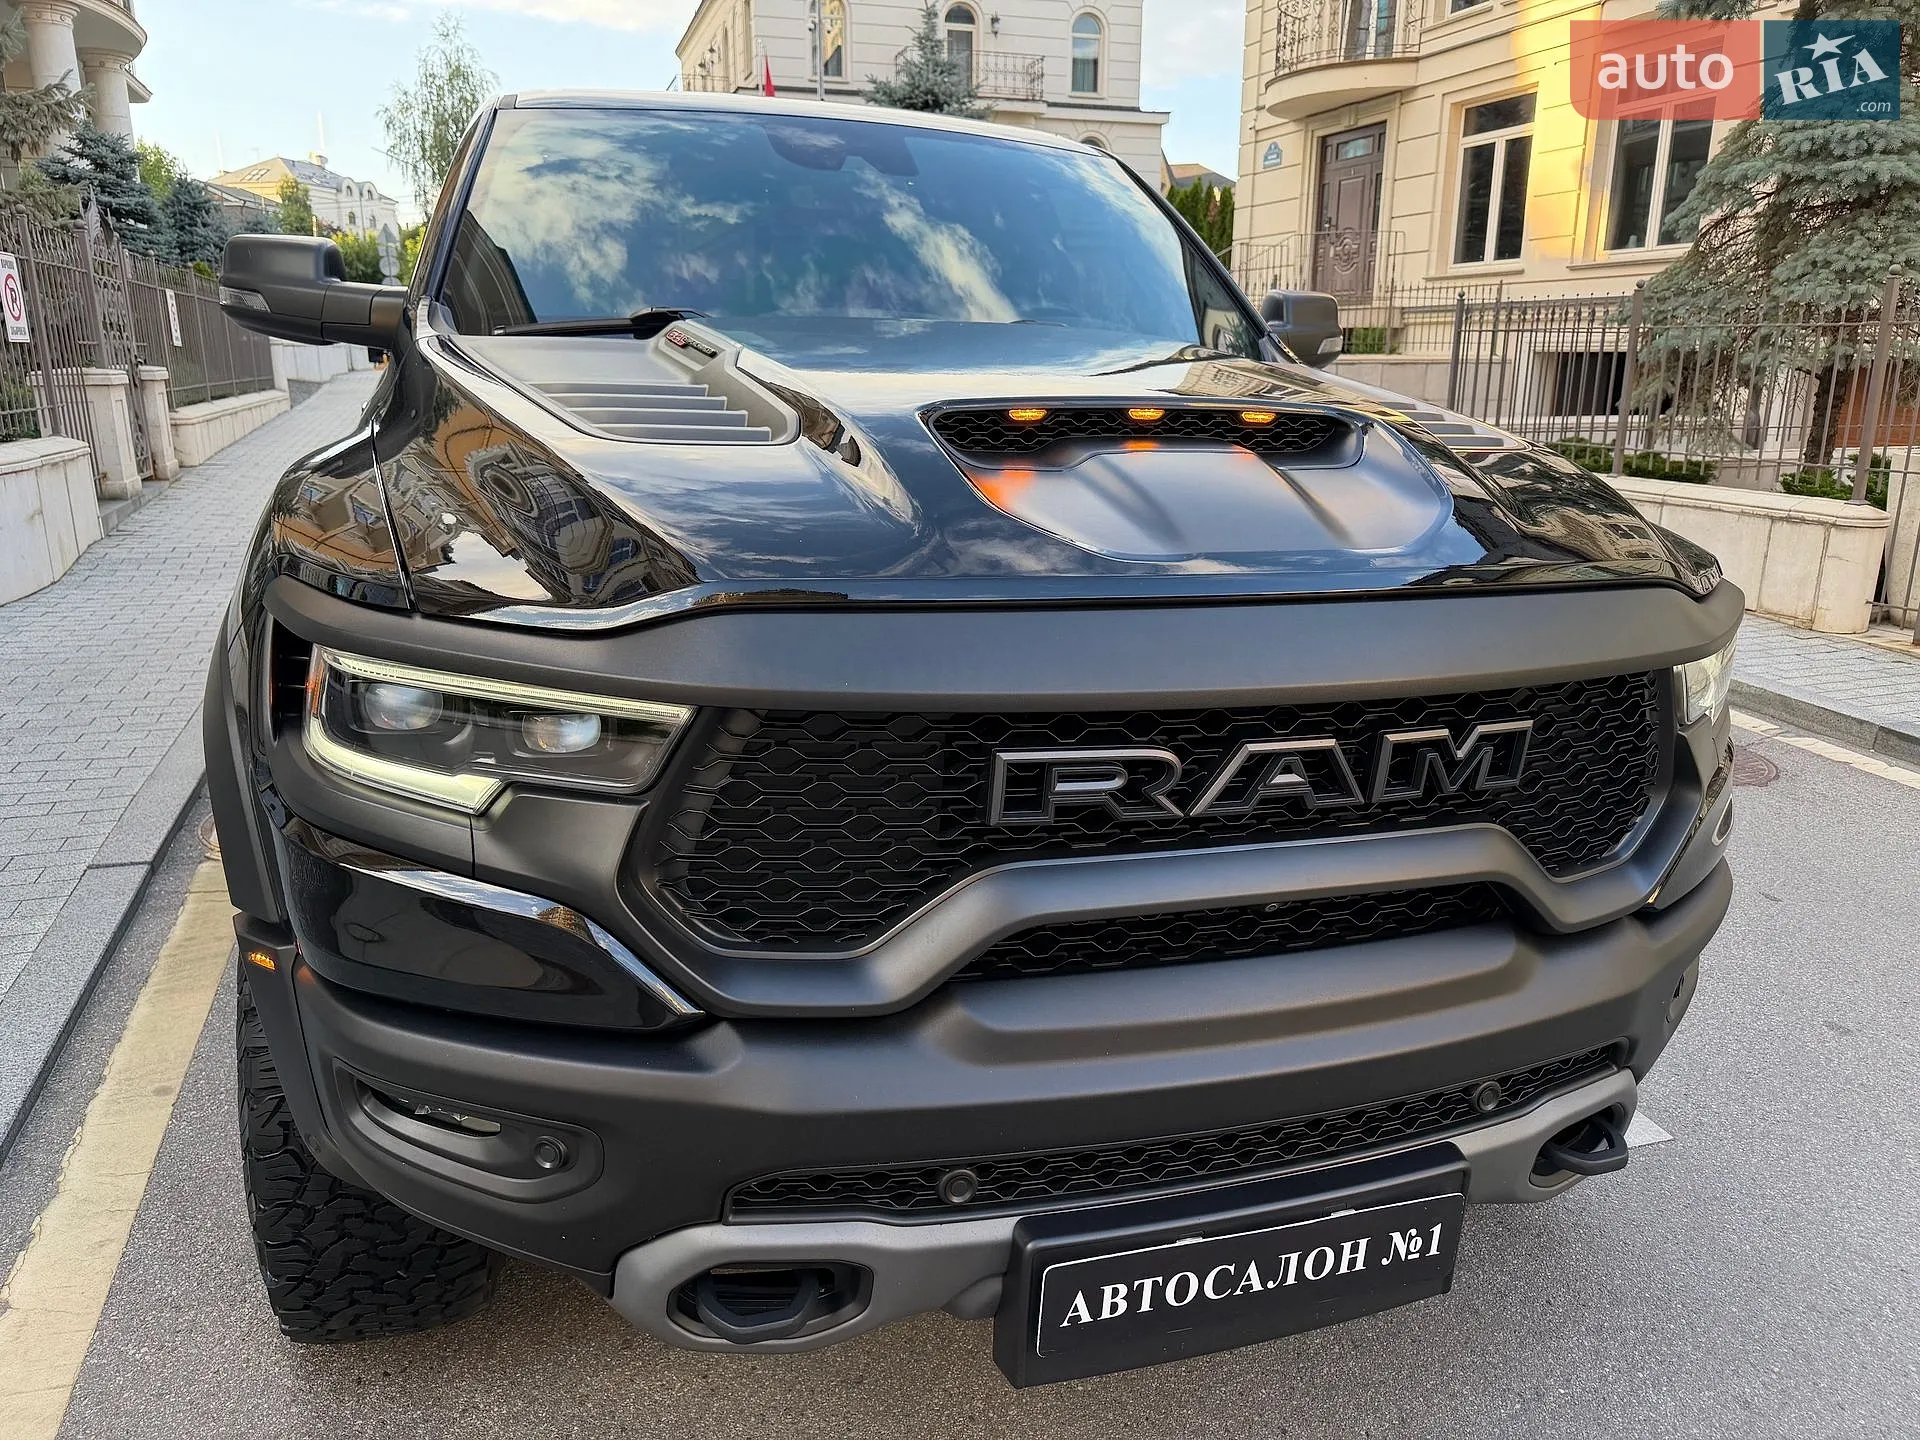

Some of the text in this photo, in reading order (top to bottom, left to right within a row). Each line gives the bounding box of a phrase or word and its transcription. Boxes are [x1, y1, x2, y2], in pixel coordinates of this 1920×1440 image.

[986, 719, 1534, 826] RAM
[1059, 1222, 1444, 1328] АВТОСАЛОН №1
